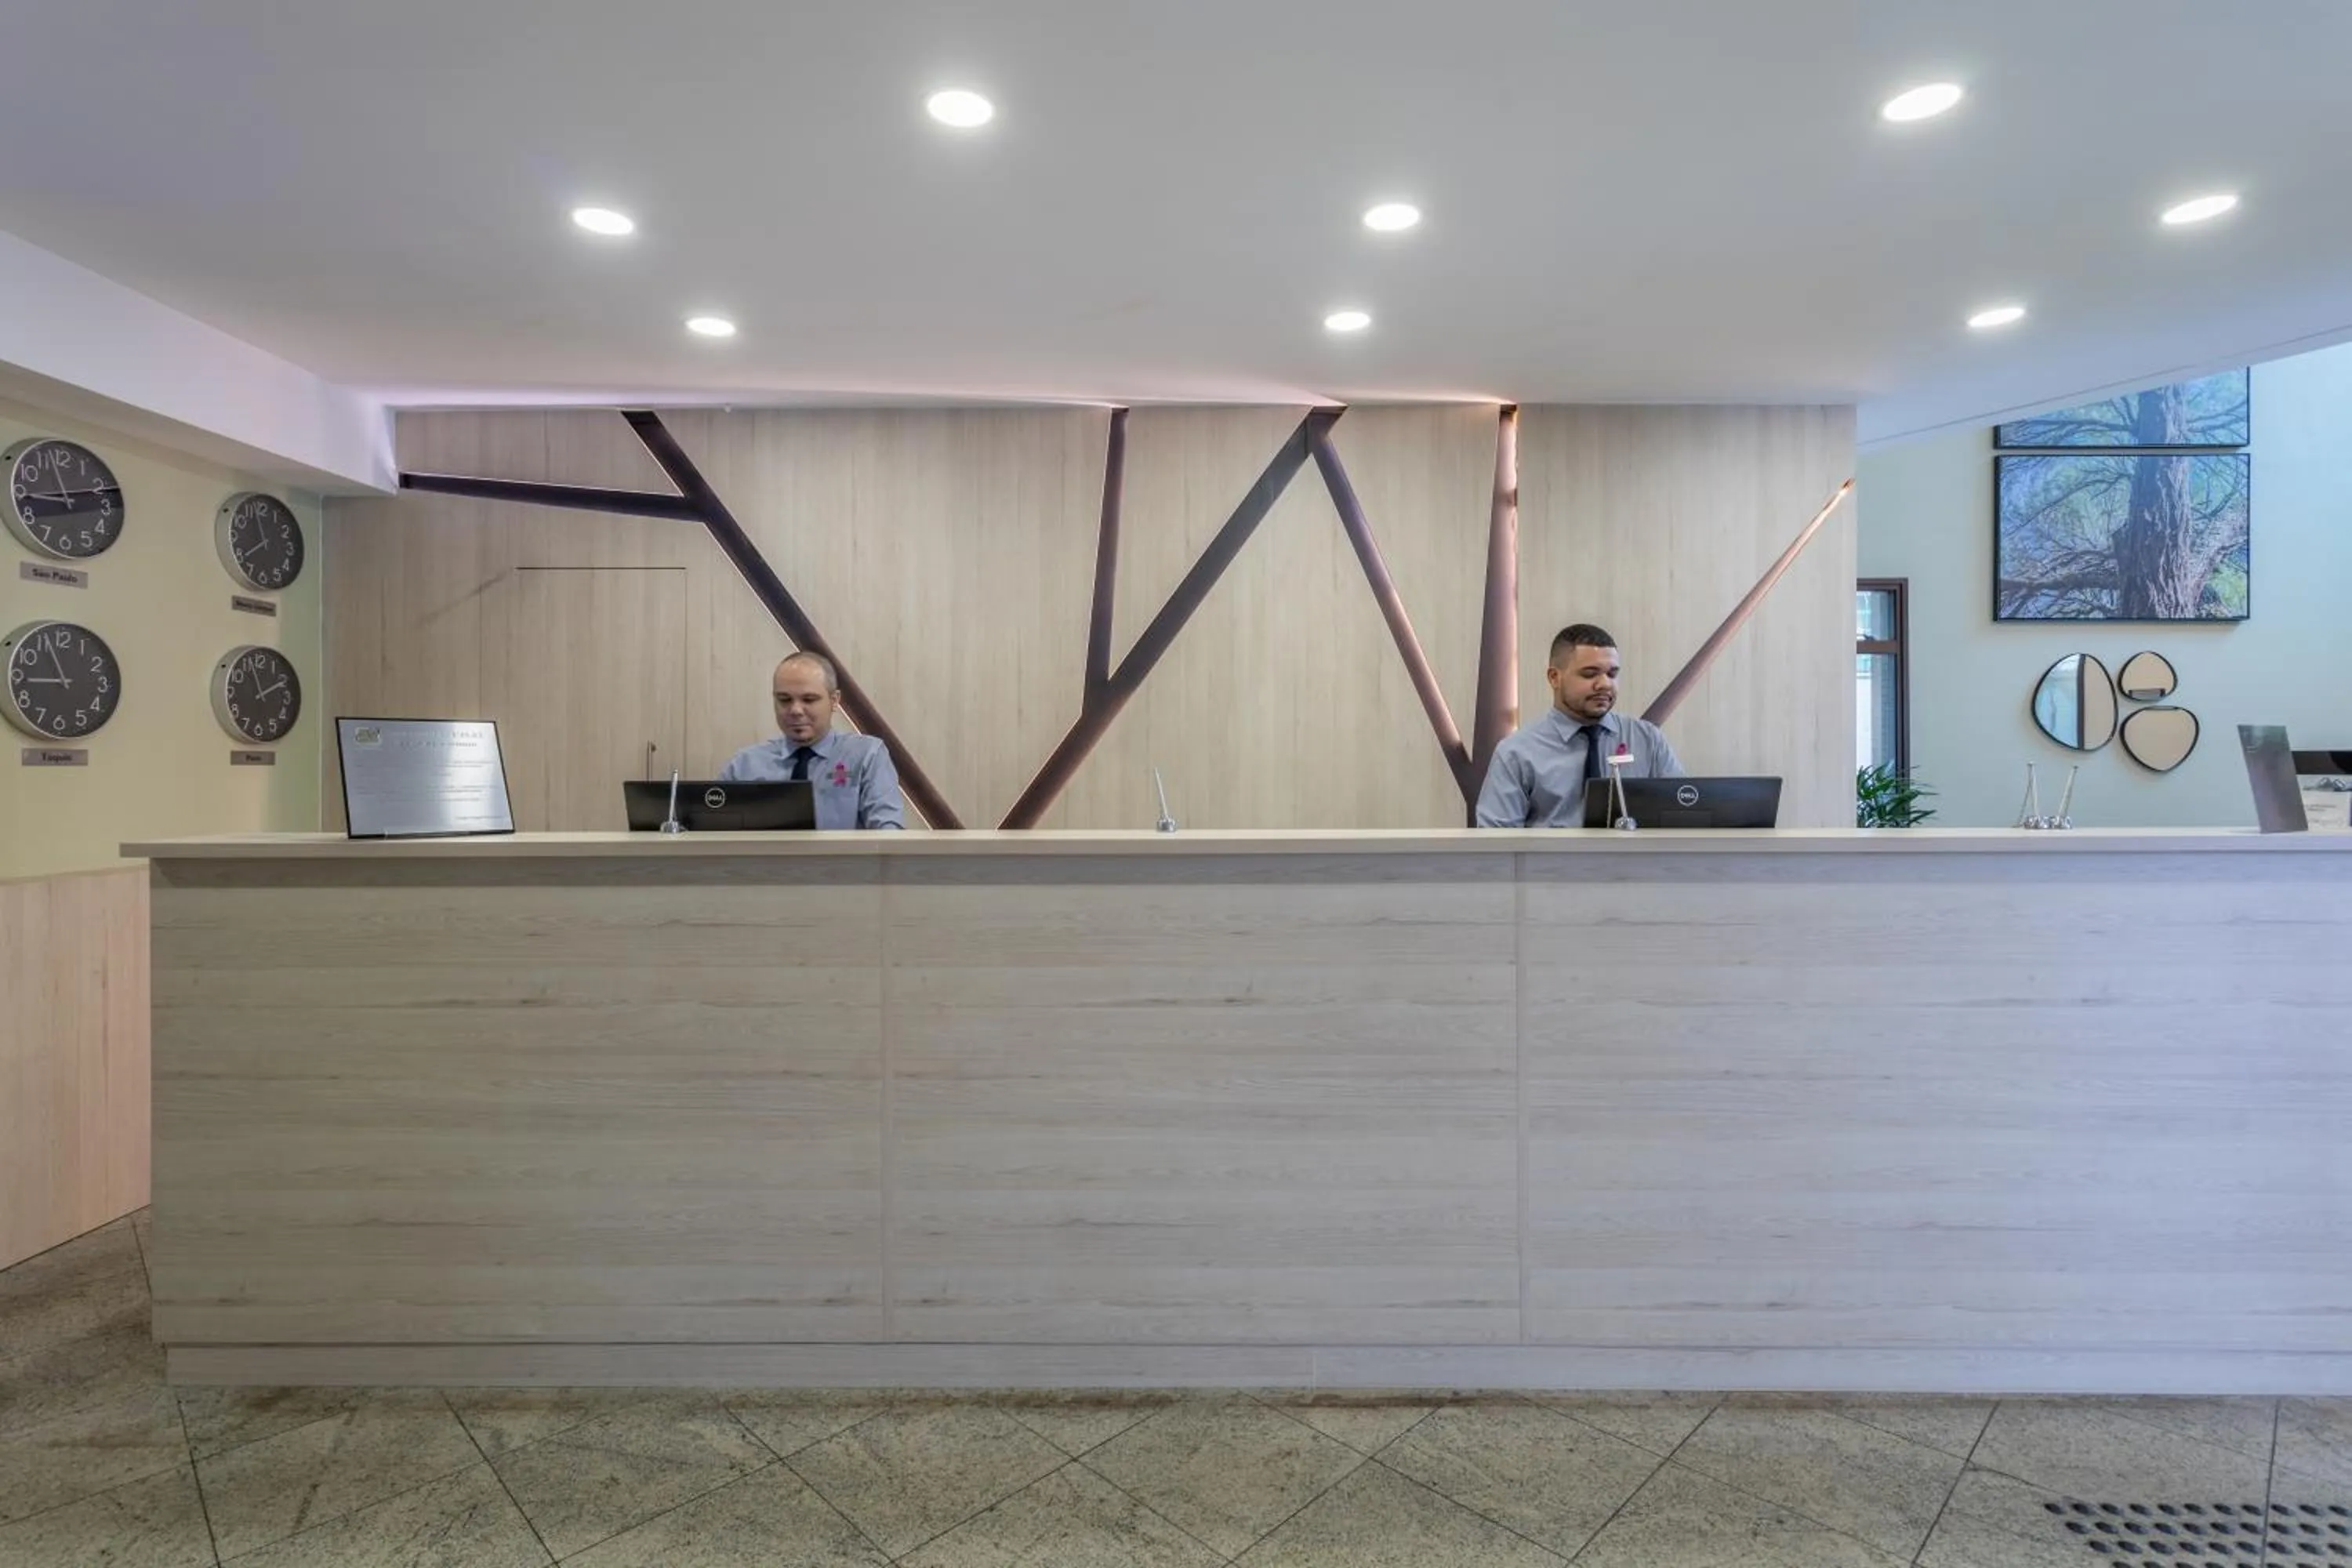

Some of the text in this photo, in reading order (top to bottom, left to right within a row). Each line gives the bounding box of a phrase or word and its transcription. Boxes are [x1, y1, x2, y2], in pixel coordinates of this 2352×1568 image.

[37, 451, 49, 470] 11
[55, 449, 71, 468] 12
[20, 464, 38, 481] 10
[80, 460, 85, 477] 1
[15, 484, 26, 500] 9
[93, 477, 104, 495] 2
[24, 506, 34, 524] 8
[101, 499, 111, 515] 3
[245, 504, 253, 519] 11
[39, 524, 51, 541] 7
[94, 518, 105, 534] 4
[281, 524, 289, 539] 2
[59, 535, 71, 550] 6
[81, 531, 93, 547] 5
[285, 542, 294, 556] 3
[245, 562, 253, 577] 7
[282, 558, 289, 571] 4
[258, 572, 267, 584] 6
[274, 567, 282, 582] 5
[38, 633, 49, 652] 11
[55, 630, 71, 648] 12
[80, 639, 84, 655] 1
[20, 648, 38, 666] 10
[90, 656, 103, 673] 2
[242, 657, 251, 672] 11
[255, 653, 266, 669] 12
[12, 668, 24, 685] 9
[97, 676, 107, 692] 3
[231, 670, 244, 684] 10
[18, 690, 31, 708] 8
[90, 695, 100, 711] 4
[283, 690, 291, 705] 3
[35, 707, 47, 724] 7
[53, 715, 66, 730] 6
[75, 710, 87, 727] 5
[241, 717, 250, 729] 7
[253, 723, 263, 736] 6
[269, 718, 278, 734] 5
